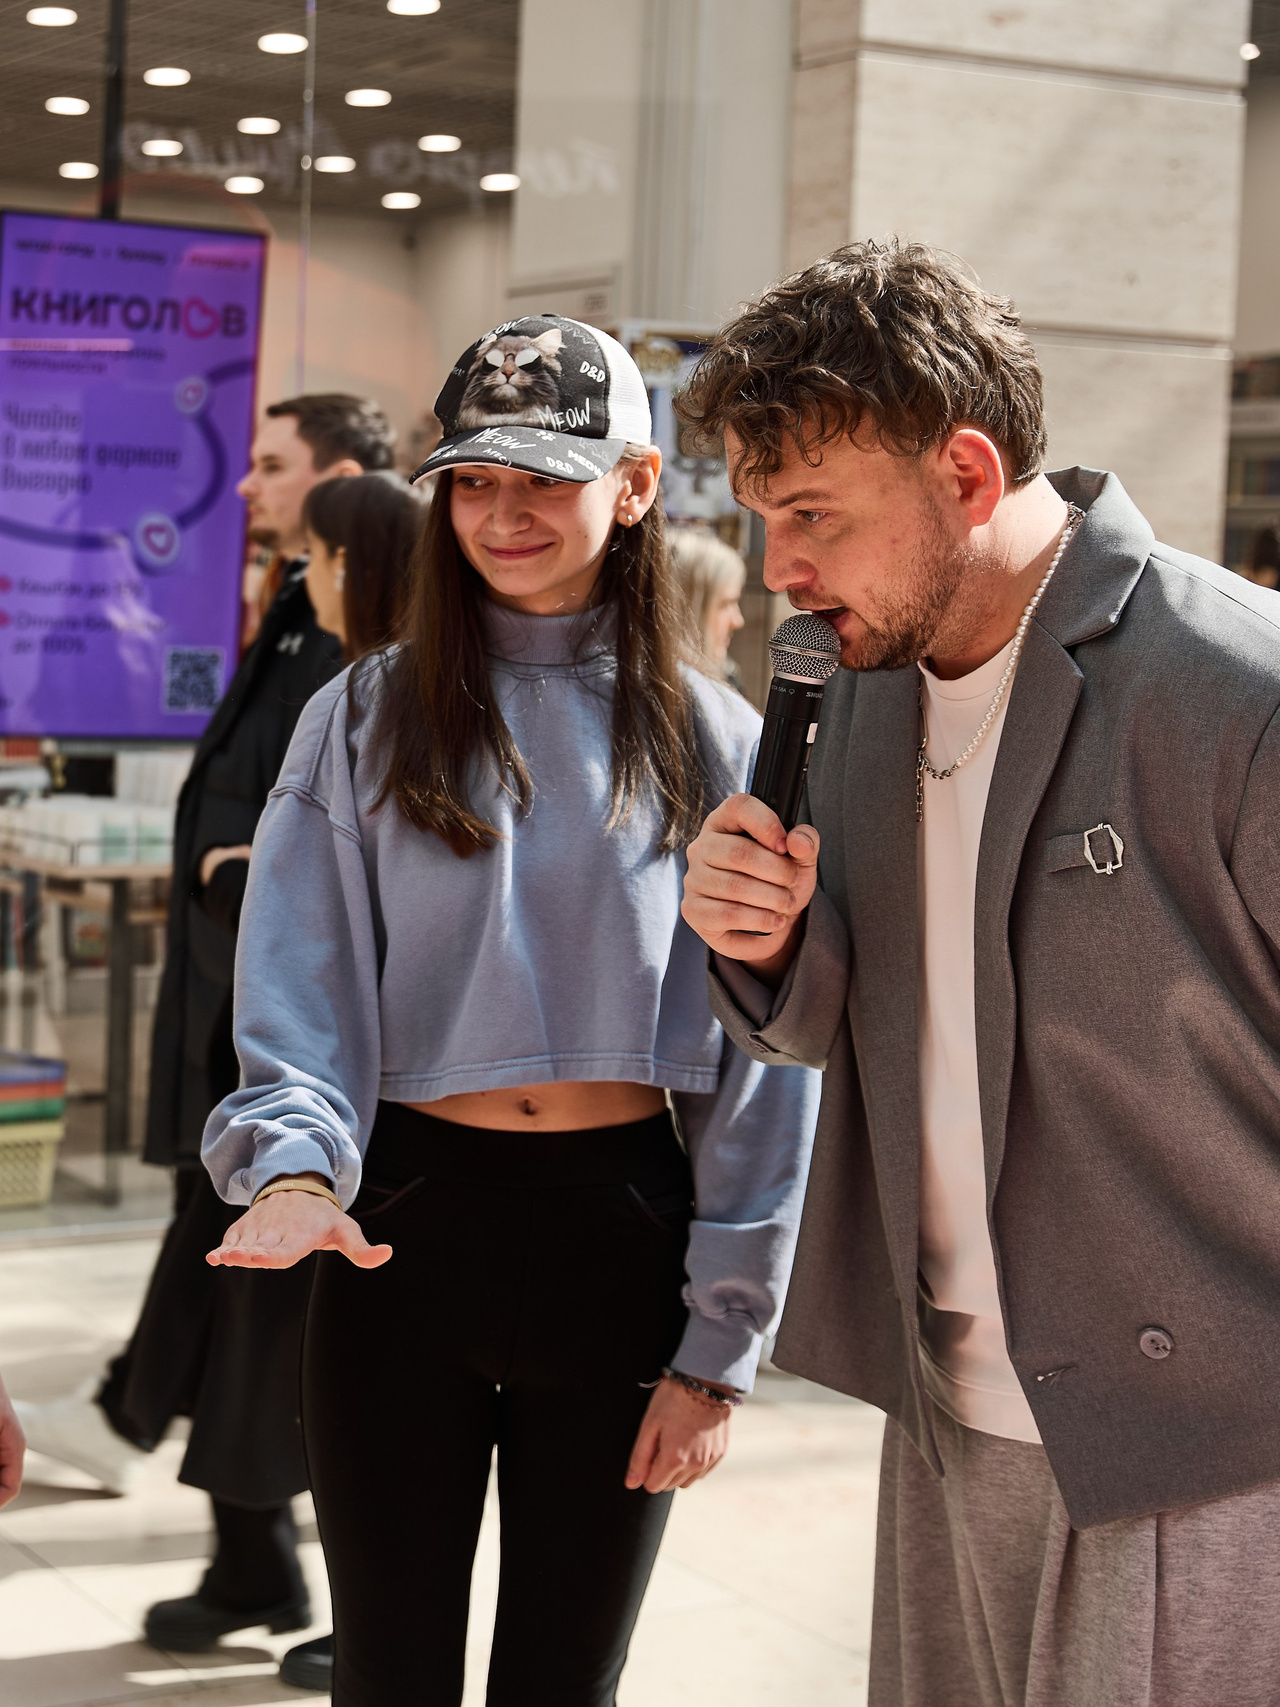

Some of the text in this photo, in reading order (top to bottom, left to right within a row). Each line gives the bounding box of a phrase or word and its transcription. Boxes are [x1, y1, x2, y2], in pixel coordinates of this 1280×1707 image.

[579, 360, 606, 383] D&D
[536, 397, 591, 432] MEOW
[469, 427, 536, 450] MEOW
[546, 456, 575, 475] D&D
[567, 450, 605, 479] MEOW
